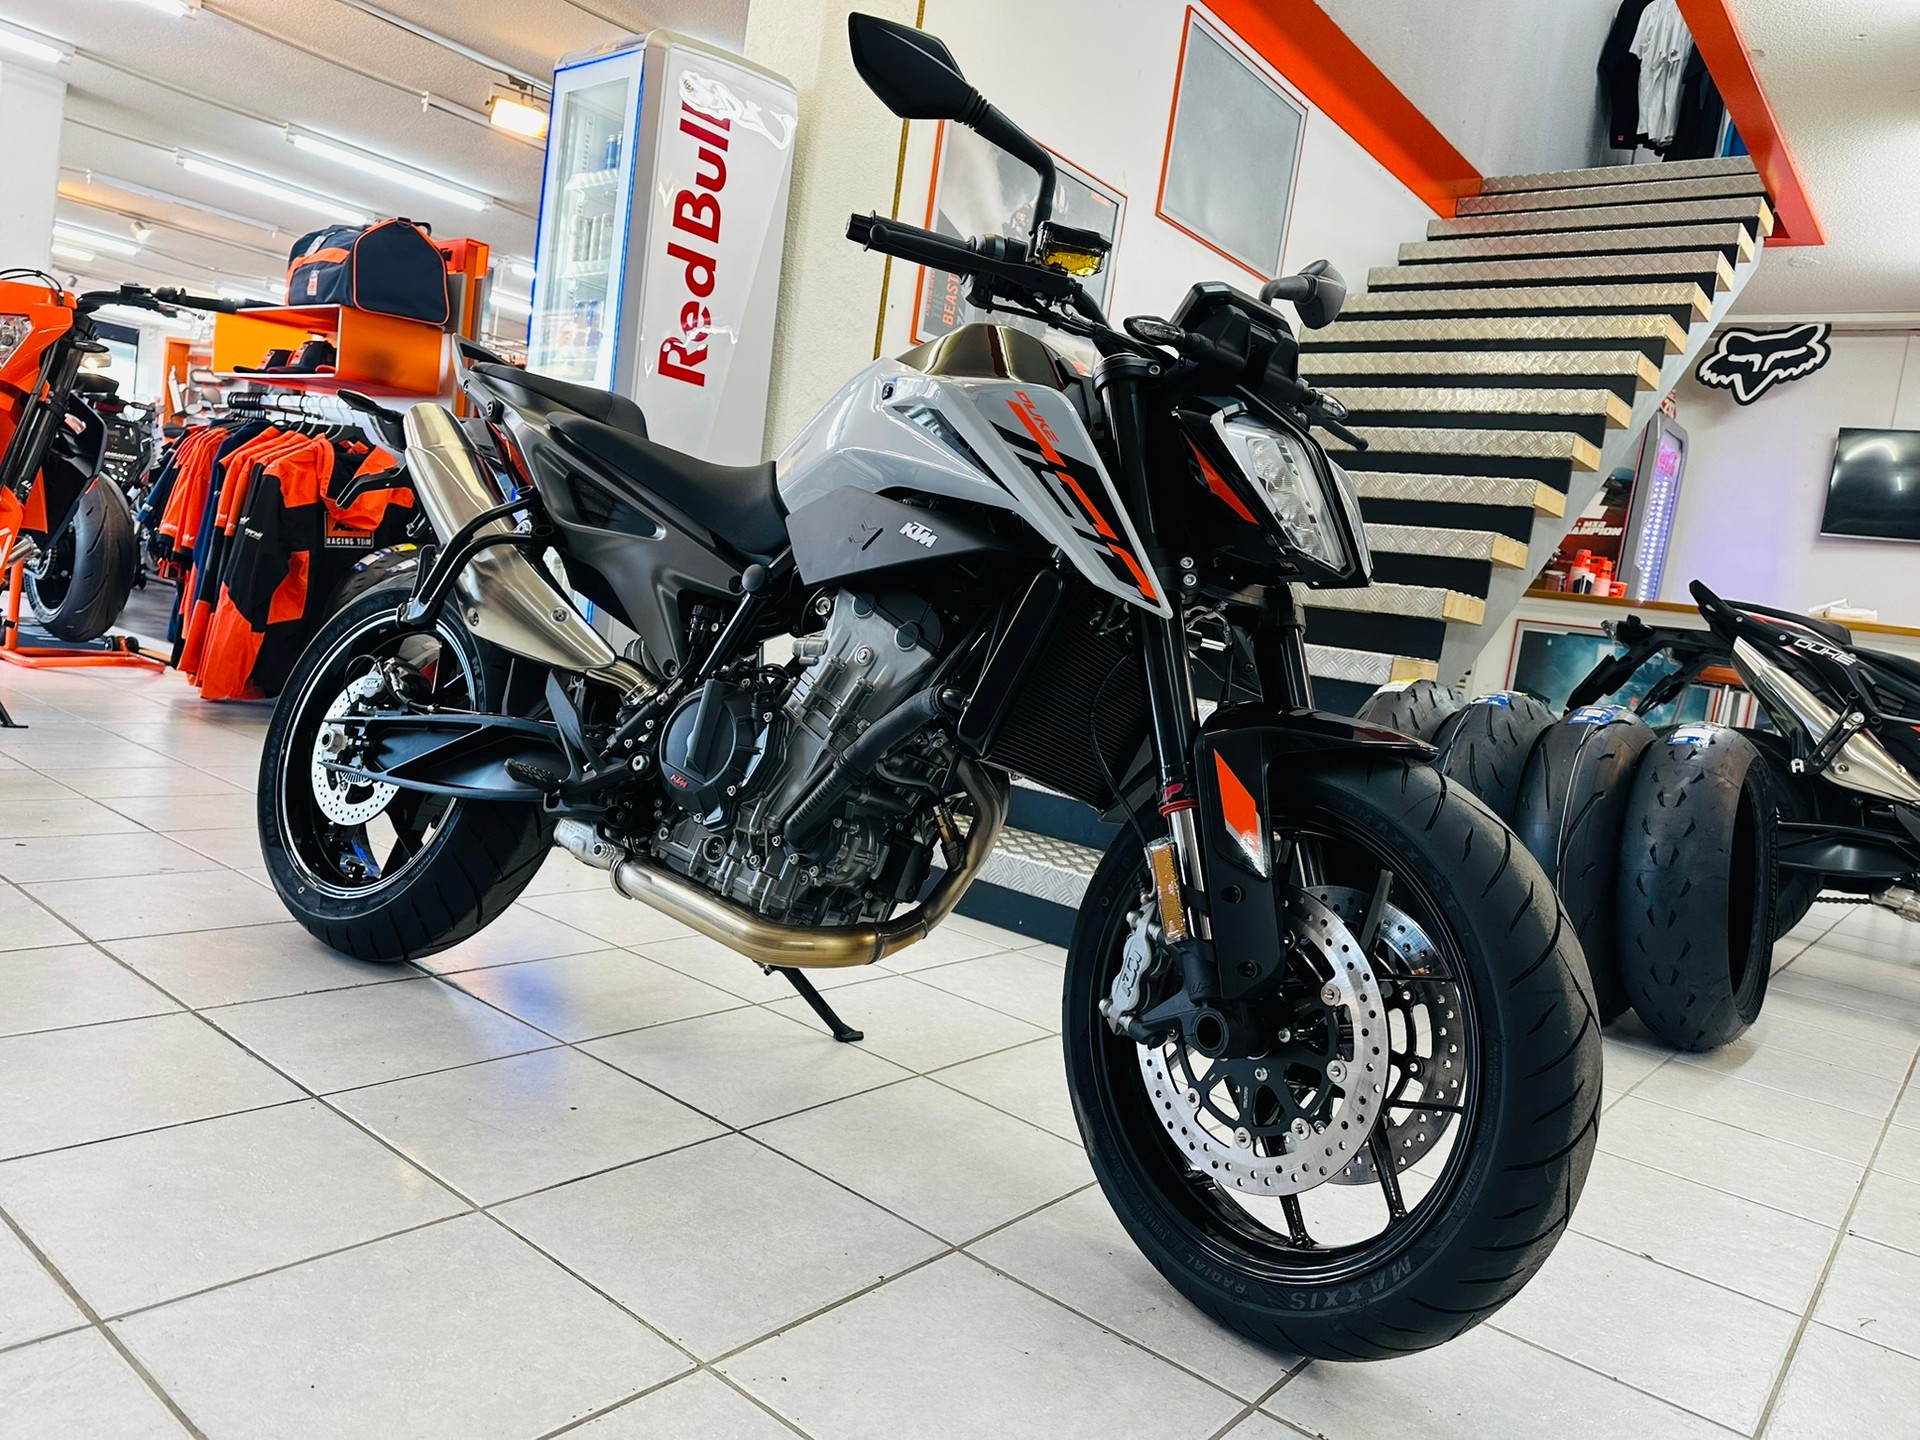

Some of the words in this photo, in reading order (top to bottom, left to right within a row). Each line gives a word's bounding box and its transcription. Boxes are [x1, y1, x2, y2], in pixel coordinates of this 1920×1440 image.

[672, 99, 731, 244] Bull
[658, 242, 717, 388] Red
[942, 273, 961, 326] BEAST
[1014, 390, 1060, 443] DUKE
[326, 537, 354, 546] RACING
[899, 521, 938, 549] KTM
[1571, 526, 1623, 536] AMPION
[1582, 520, 1607, 528] MX2
[1794, 639, 1857, 666] DUKE
[1184, 1251, 1247, 1295] RADIAL
[1289, 1255, 1413, 1310] MAXXIS
